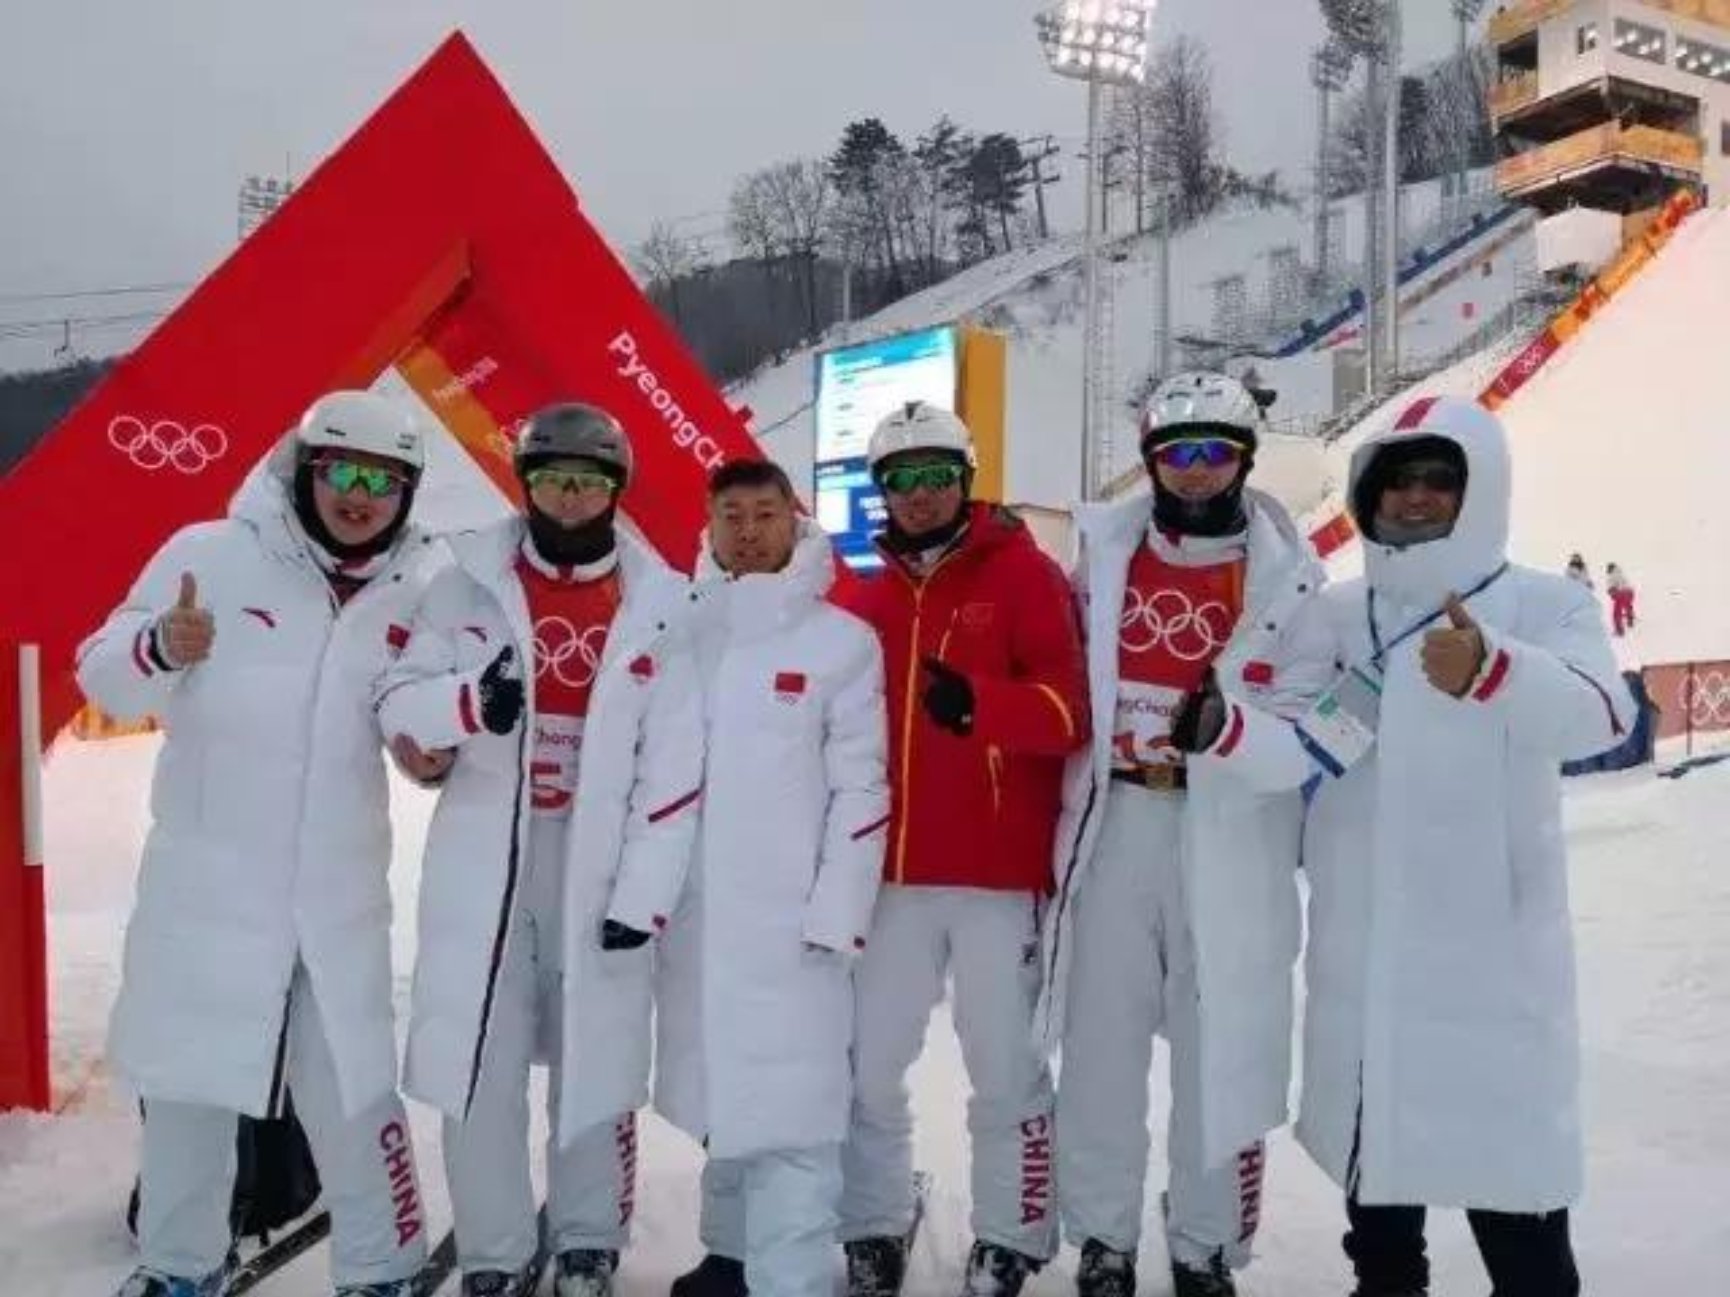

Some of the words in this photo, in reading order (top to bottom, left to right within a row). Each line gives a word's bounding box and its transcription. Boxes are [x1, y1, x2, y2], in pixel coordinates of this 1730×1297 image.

[380, 1121, 421, 1247] CHINA
[1020, 1114, 1049, 1225] CHINA
[1238, 1140, 1262, 1243] HINA
